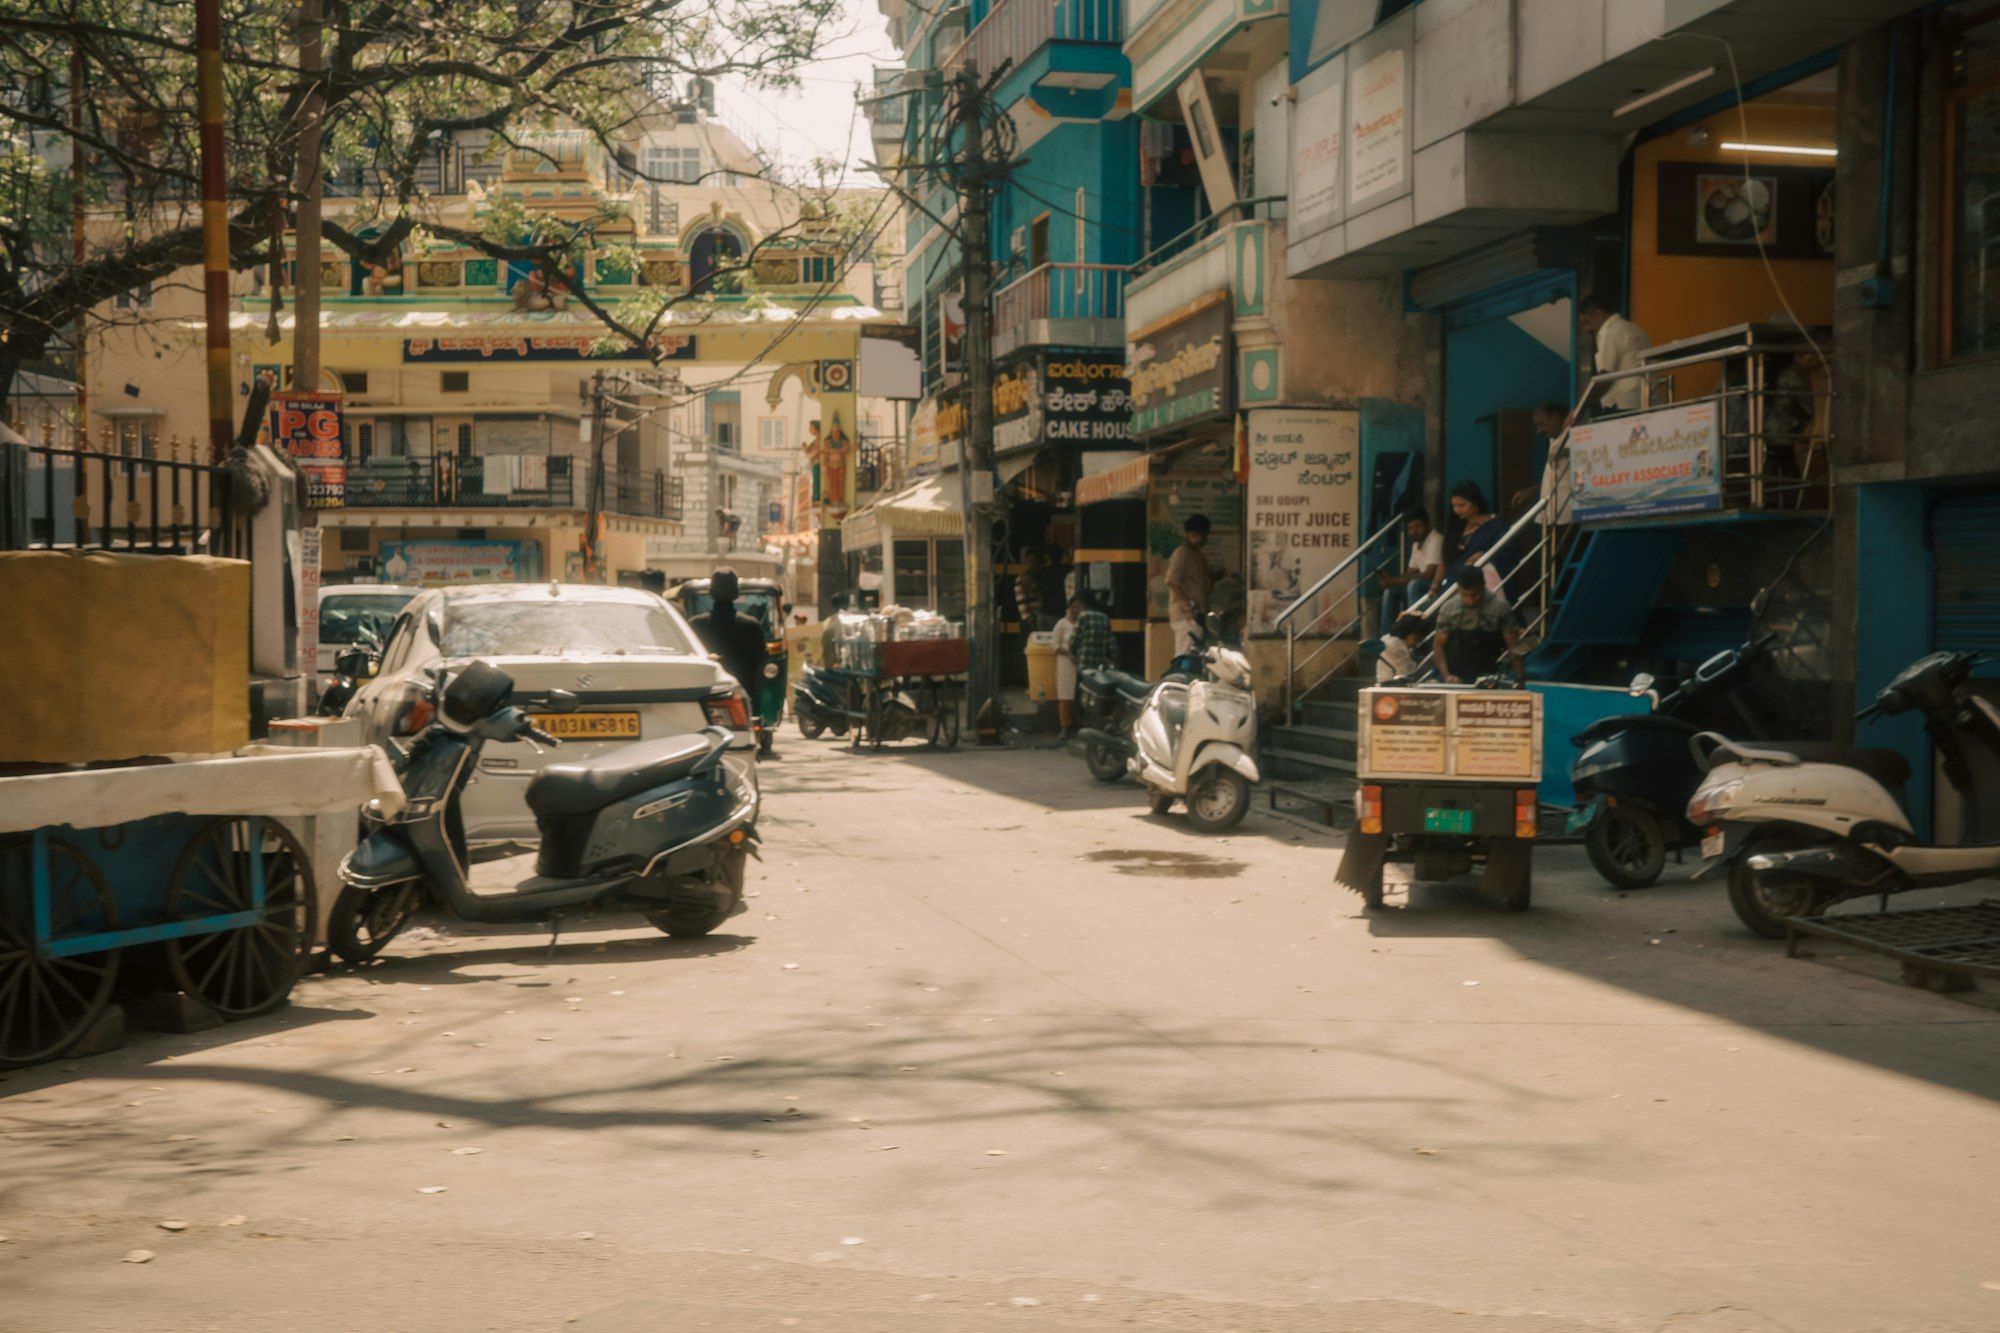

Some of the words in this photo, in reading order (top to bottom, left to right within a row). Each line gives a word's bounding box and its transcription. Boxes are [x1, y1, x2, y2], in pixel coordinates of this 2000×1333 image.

[1047, 386, 1097, 412] ಕೇಕ್
[280, 409, 339, 439] PG
[1047, 421, 1089, 438] CAKE
[1092, 421, 1134, 439] HOUS
[1304, 451, 1351, 471] ಜ್ಯೂಸ್
[1298, 470, 1352, 486] ಸೆಂಟರ್
[1591, 472, 1630, 488] GALAXY
[1633, 461, 1692, 482] ASSOCIATE
[1256, 495, 1273, 506] SRI
[1277, 495, 1310, 506] UDUPI
[1256, 512, 1300, 527] FRUIT
[1305, 512, 1351, 527] JUICE
[1291, 533, 1351, 547] CENTRE
